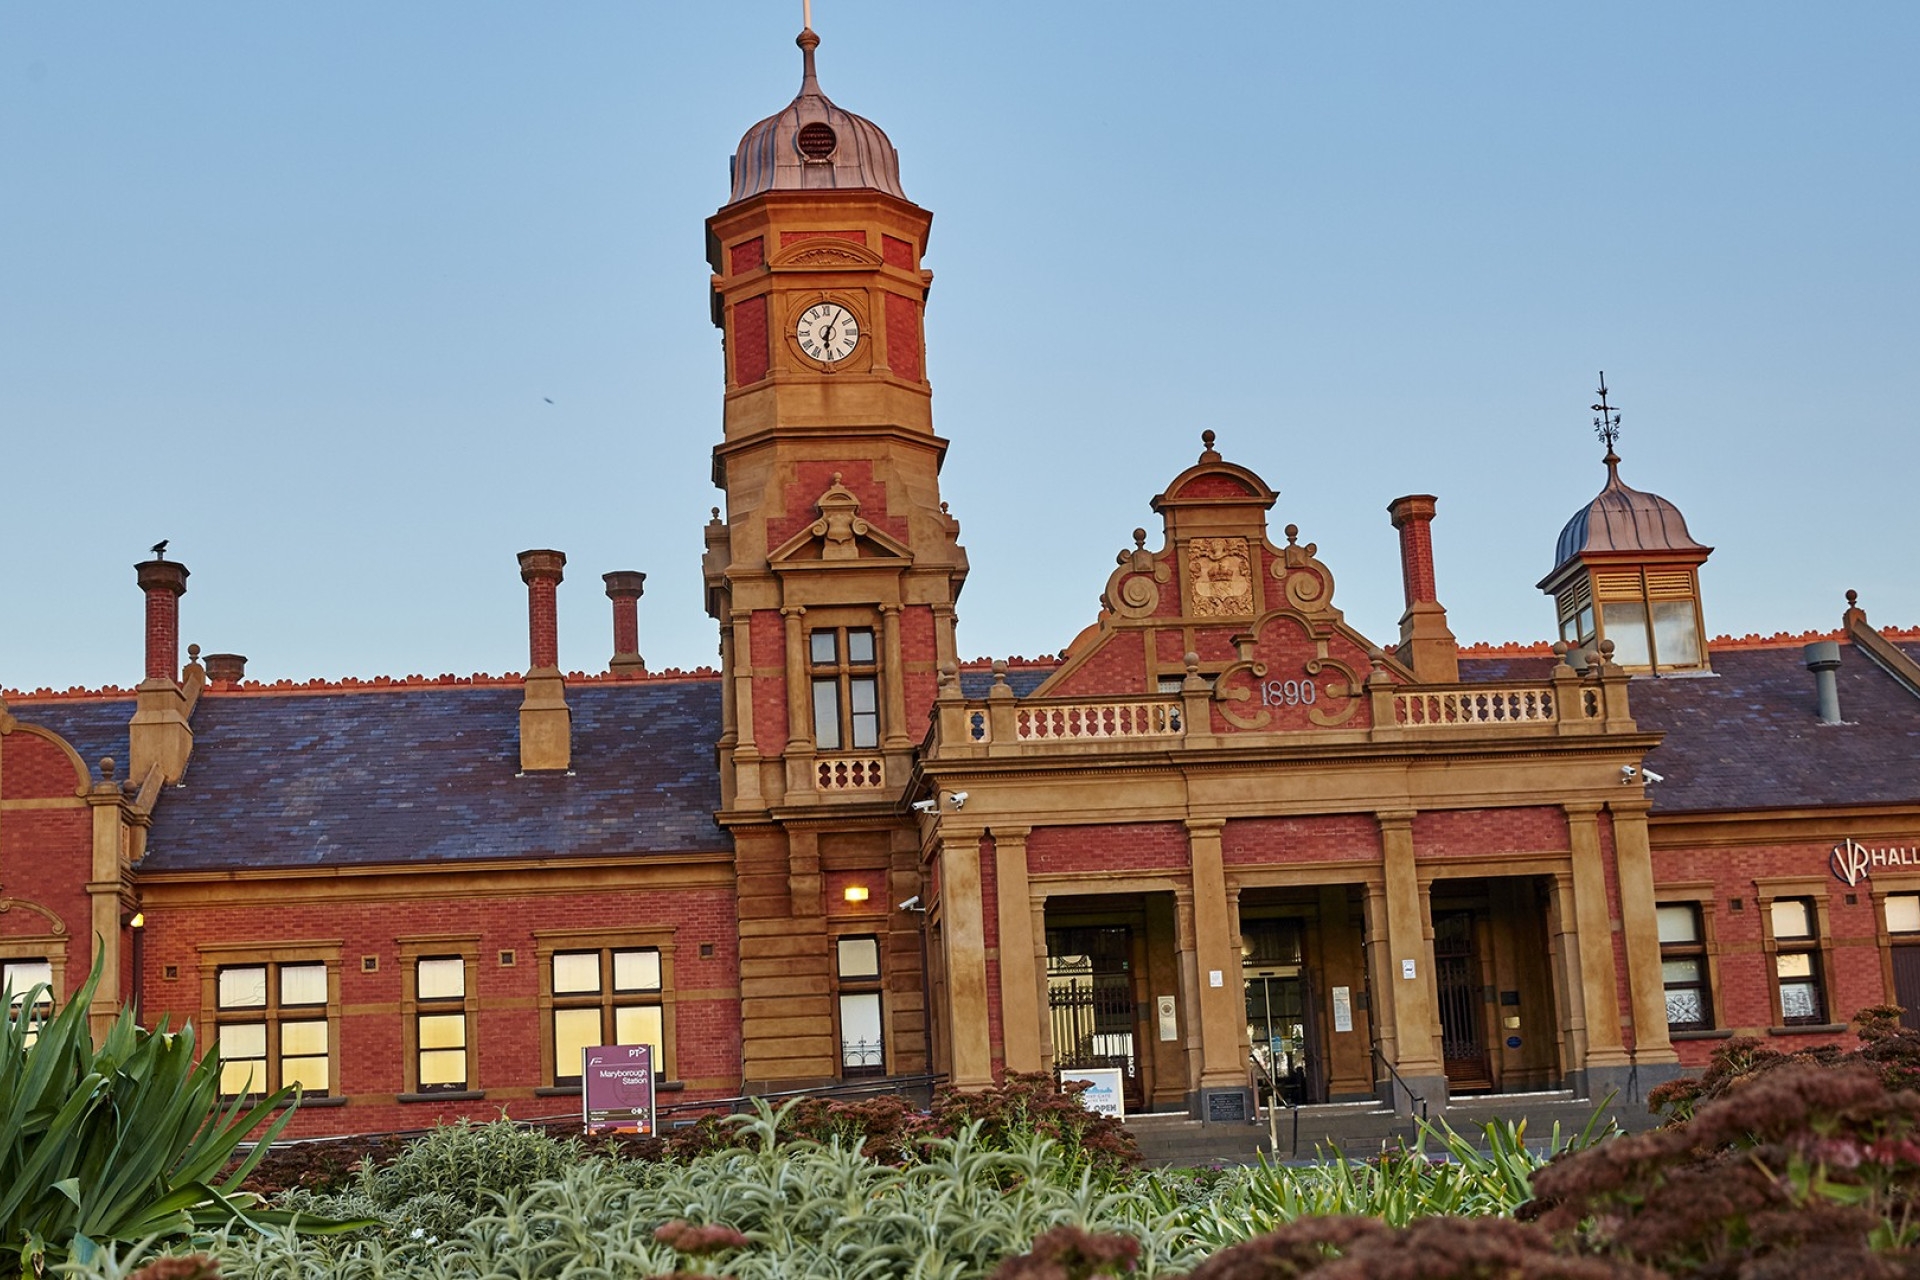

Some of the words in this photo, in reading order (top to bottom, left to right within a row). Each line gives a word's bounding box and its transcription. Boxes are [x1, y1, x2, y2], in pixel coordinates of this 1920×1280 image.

[1260, 679, 1316, 706] 1890
[1871, 847, 1920, 866] HALL
[599, 1069, 647, 1079] Maryborough
[622, 1077, 647, 1085] Station
